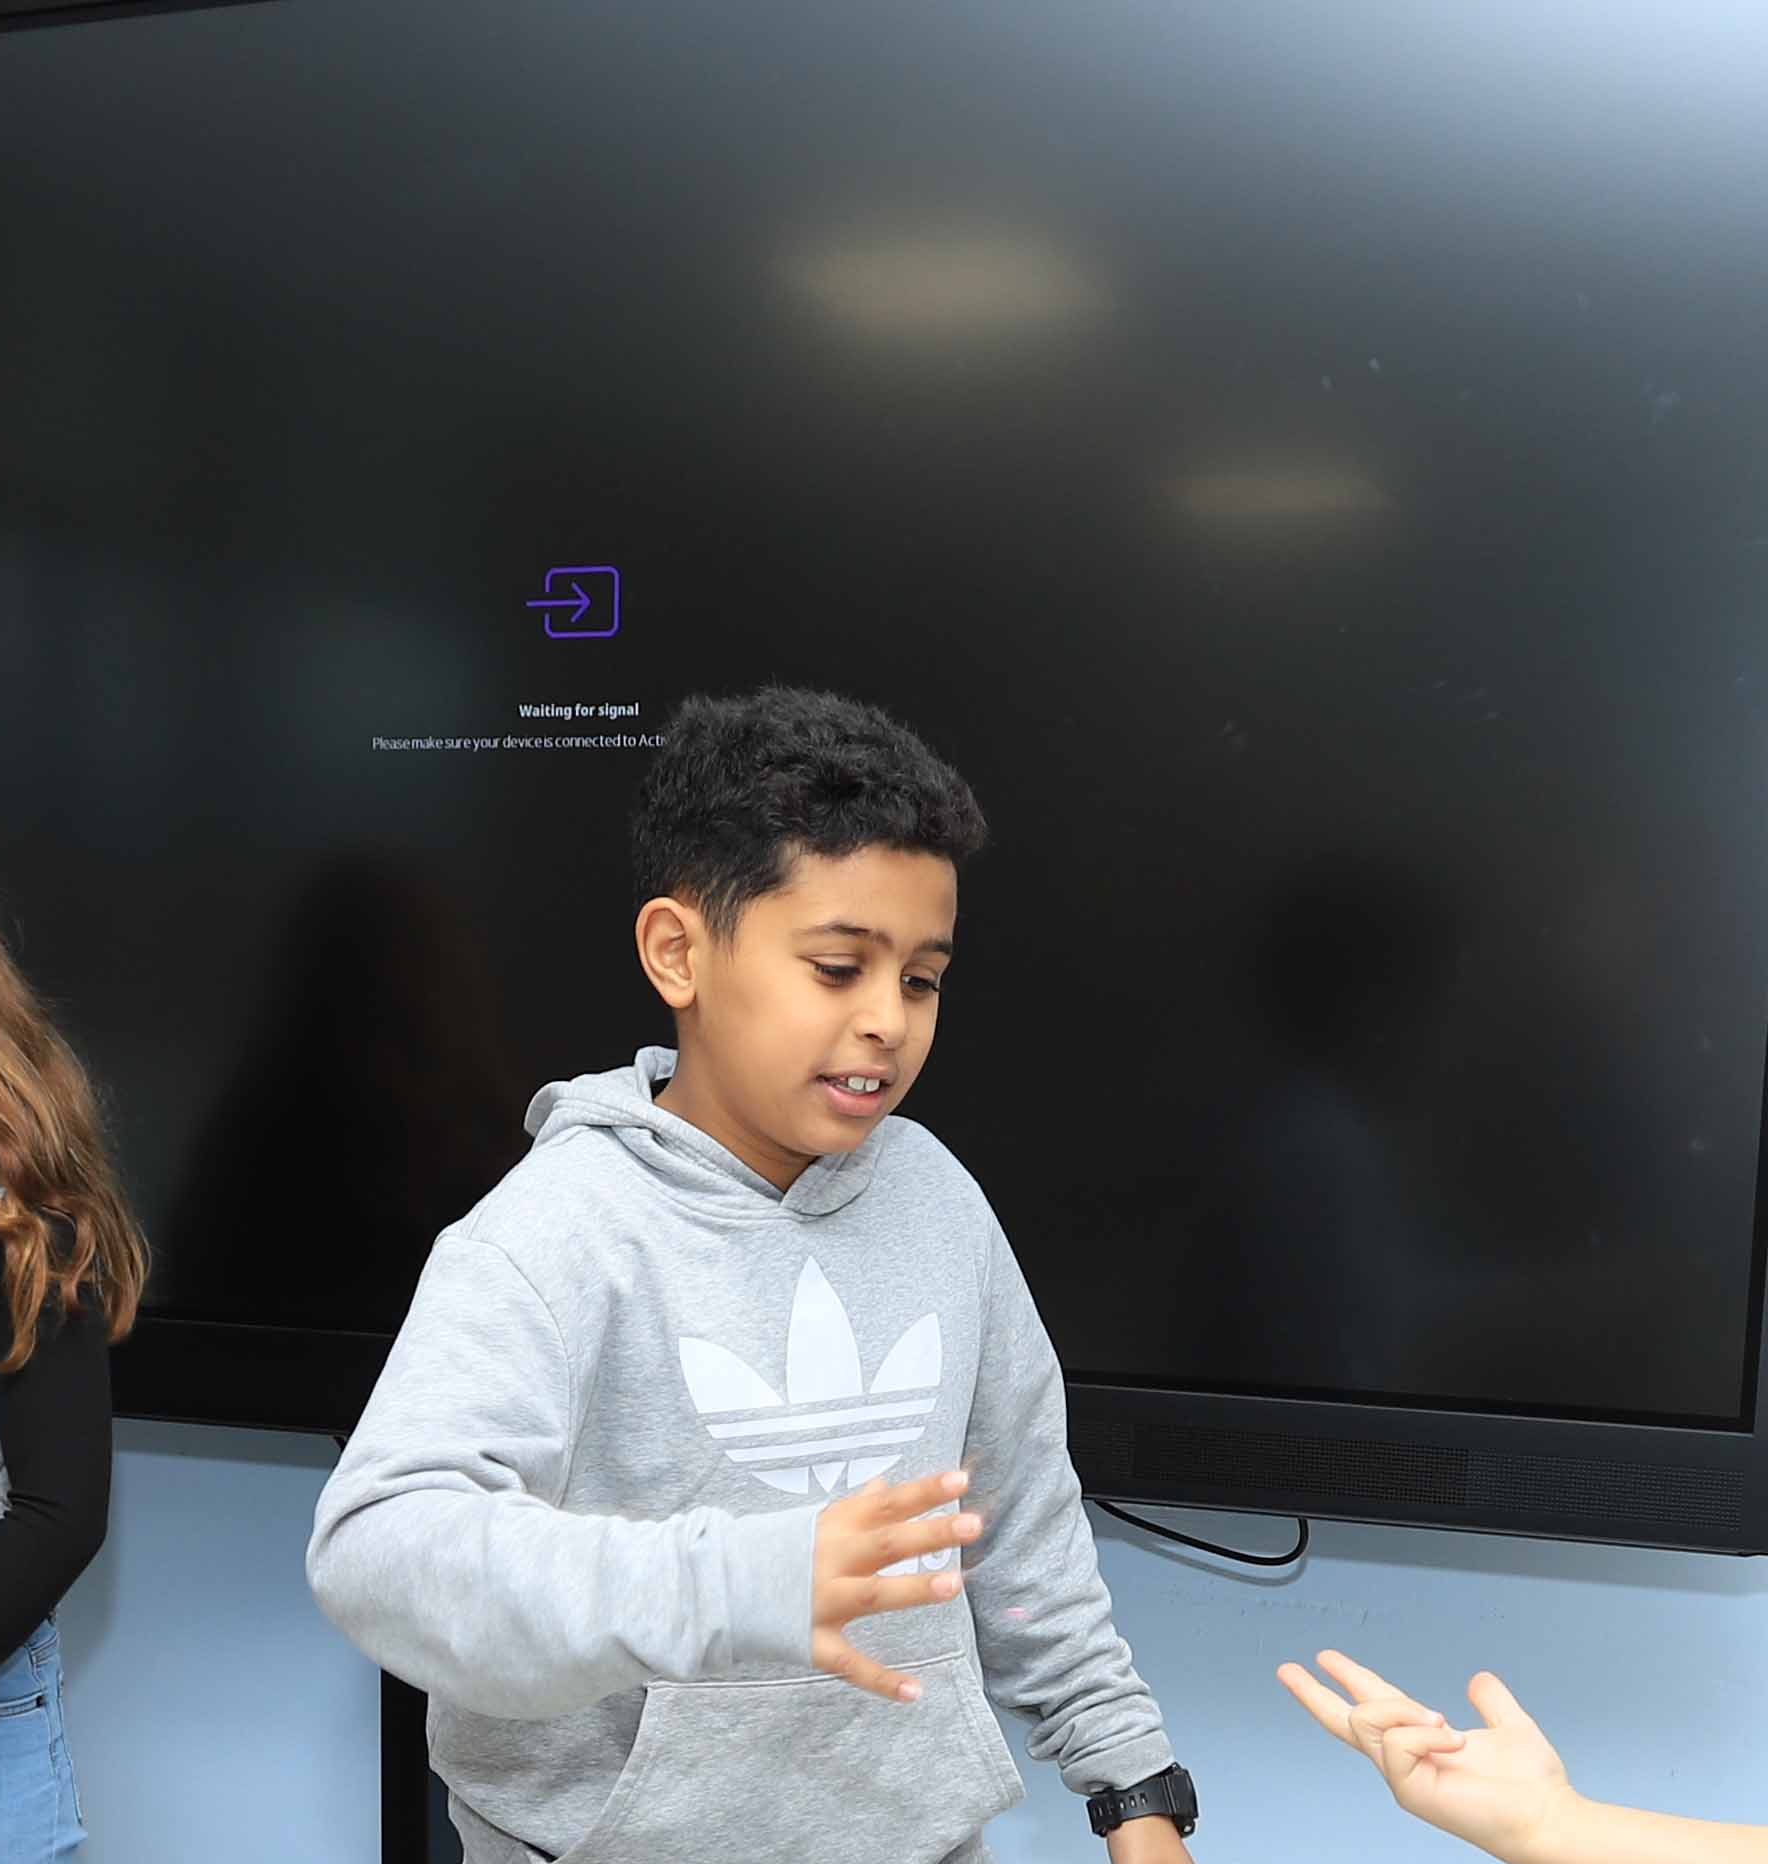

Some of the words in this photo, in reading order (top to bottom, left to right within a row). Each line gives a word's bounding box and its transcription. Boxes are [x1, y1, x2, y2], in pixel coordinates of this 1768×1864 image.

[518, 703, 573, 721] Waiting
[575, 702, 596, 718] for
[598, 702, 640, 721] signal
[372, 736, 410, 750] Please
[411, 735, 443, 750] make
[444, 738, 473, 749] sure
[473, 737, 500, 752] your
[502, 734, 542, 749] device
[544, 734, 553, 748] is
[554, 733, 621, 748] connected
[623, 734, 636, 747] to
